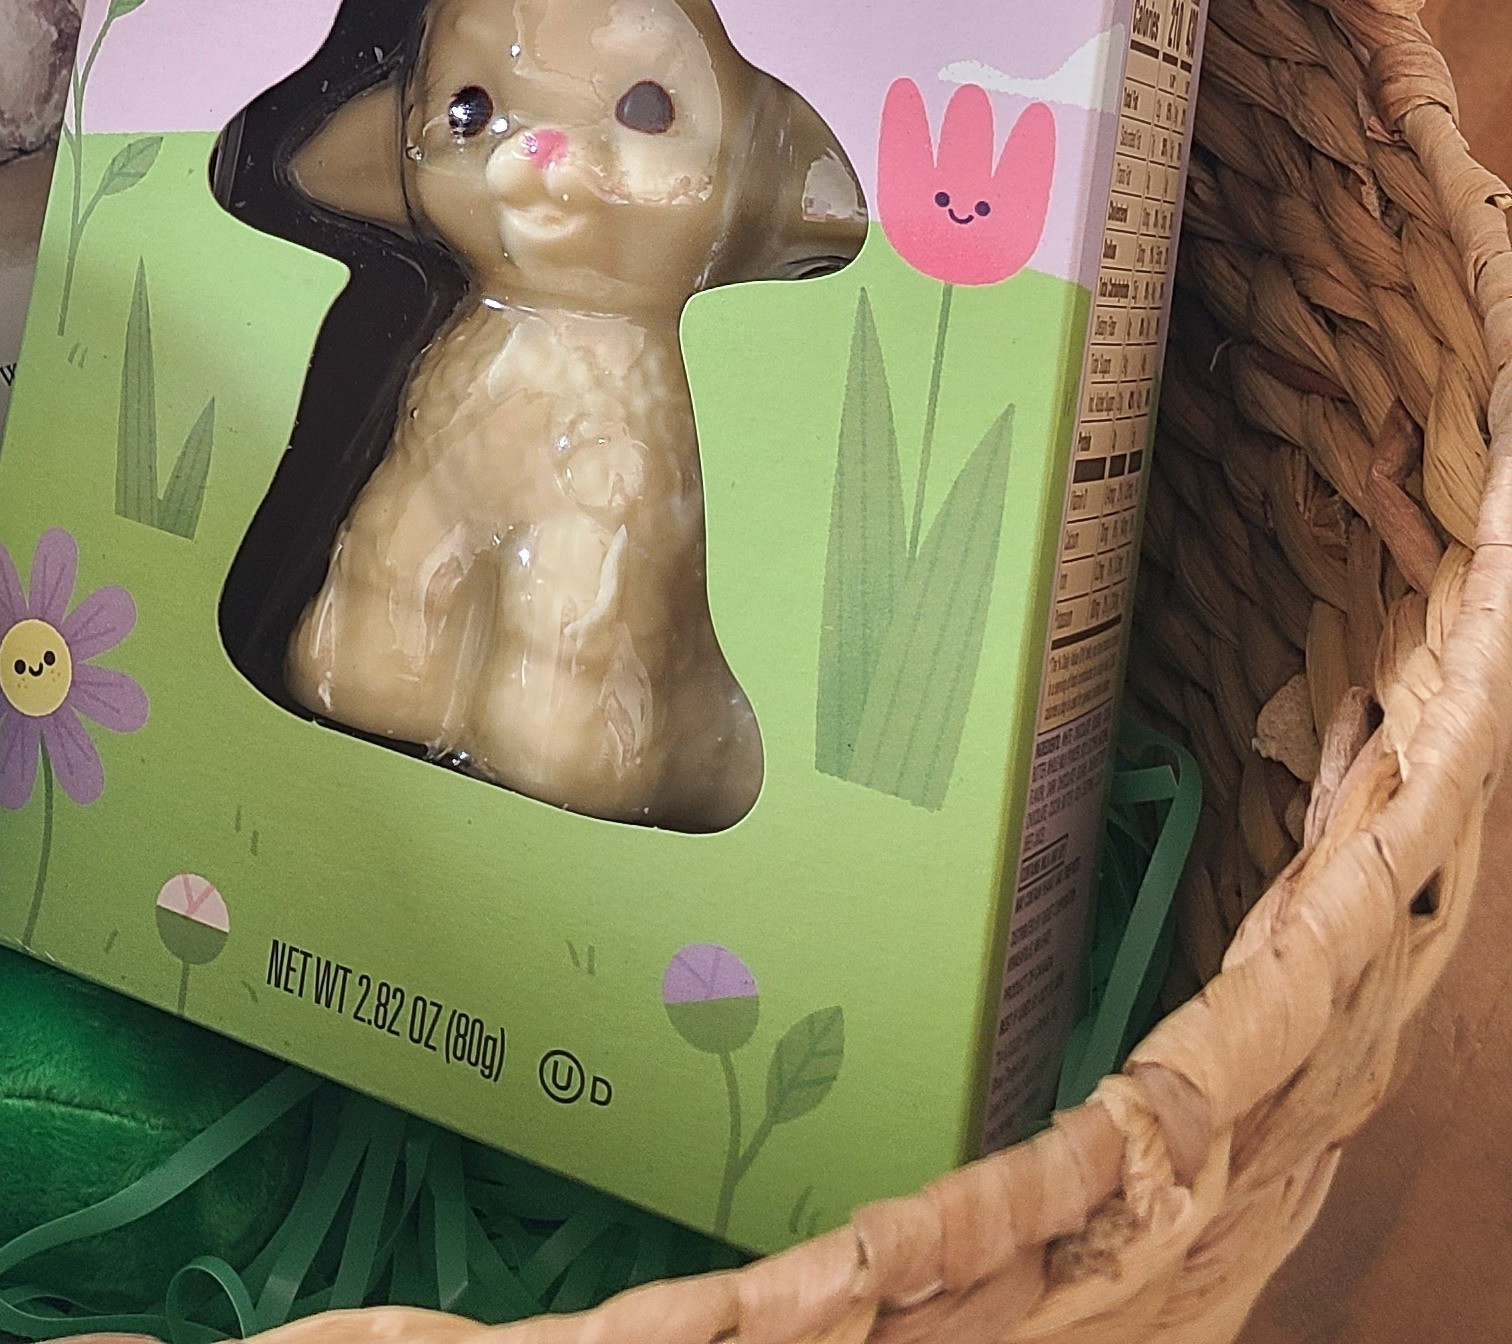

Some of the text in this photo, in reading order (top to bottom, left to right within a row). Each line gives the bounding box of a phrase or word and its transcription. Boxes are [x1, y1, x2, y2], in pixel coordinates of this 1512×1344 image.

[266, 939, 507, 1083] NET WT 2.82 OZ (80g)
